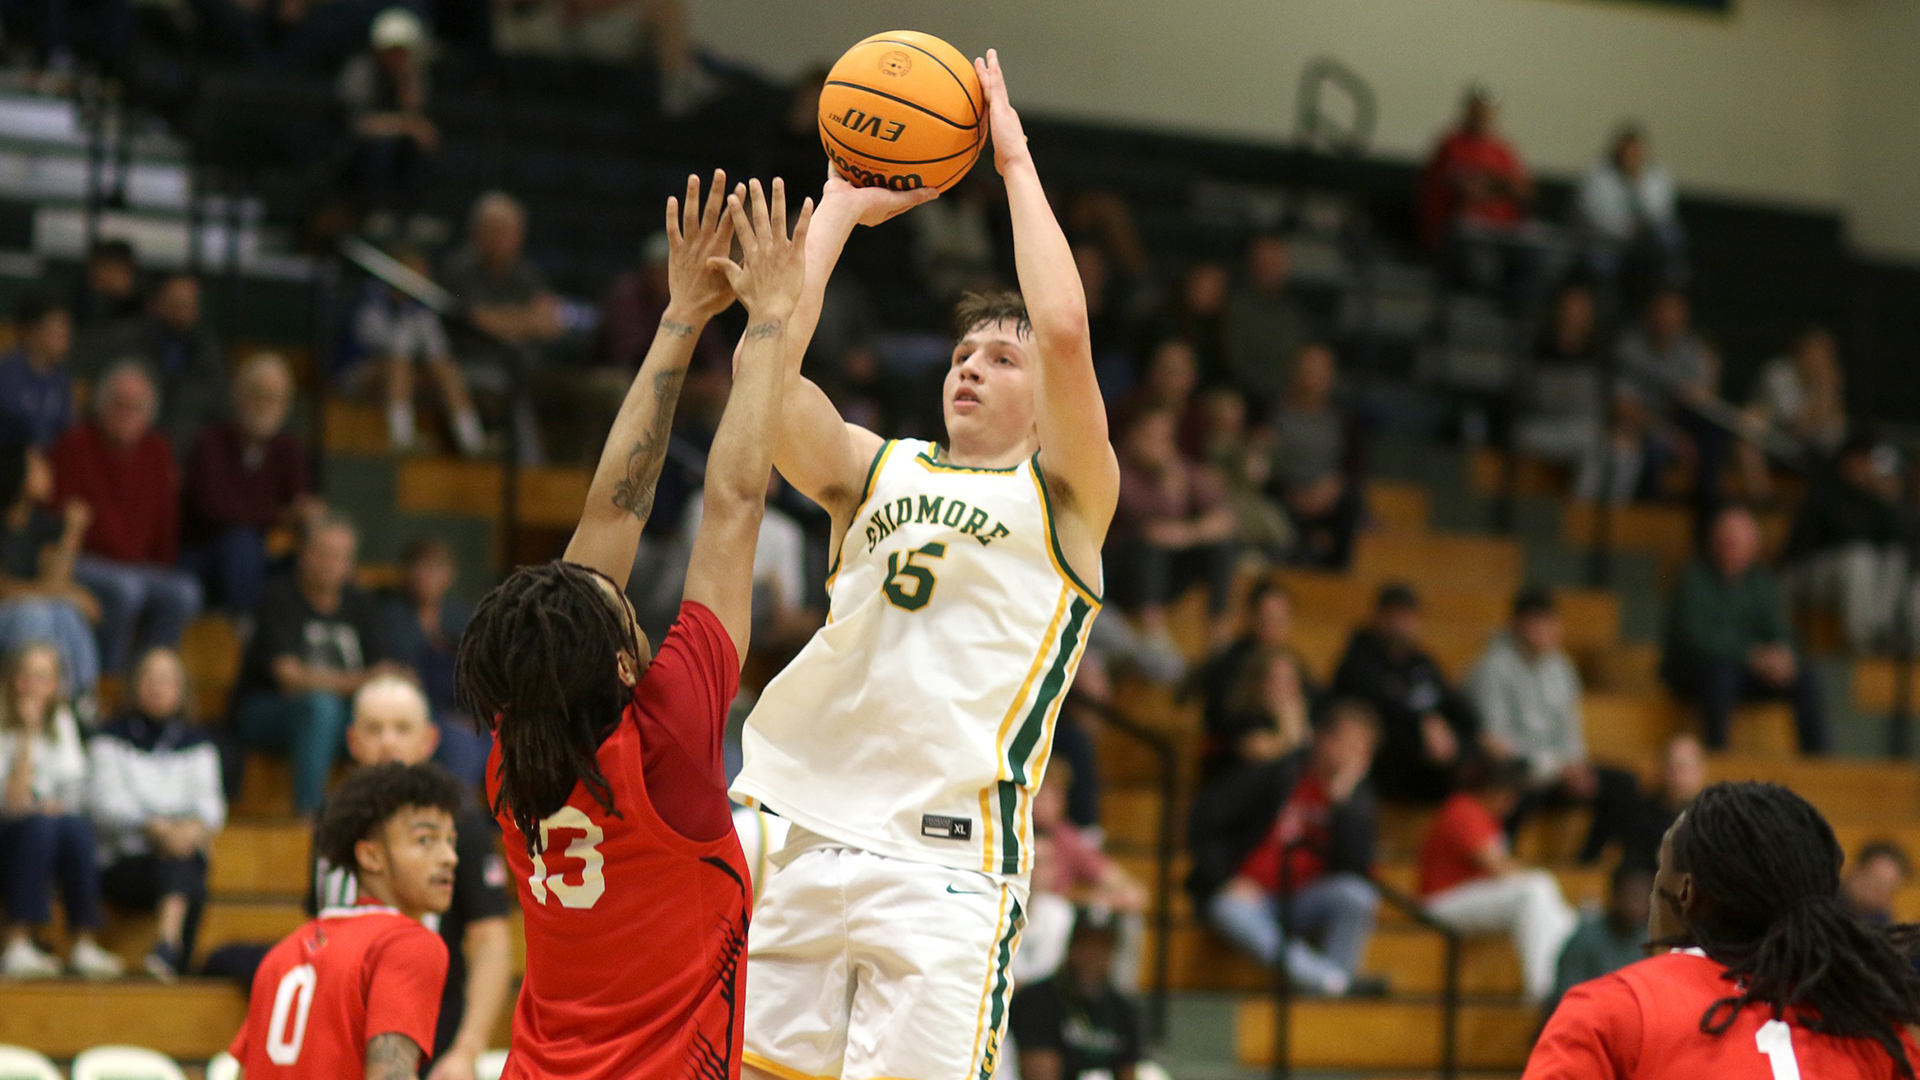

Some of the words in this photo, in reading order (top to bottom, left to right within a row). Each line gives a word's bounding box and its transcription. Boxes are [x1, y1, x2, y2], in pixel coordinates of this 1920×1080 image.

[841, 108, 906, 142] EVO
[865, 494, 1010, 554] SKIDMORE
[882, 541, 948, 612] 15
[513, 805, 605, 909] 13
[954, 823, 967, 835] XL
[266, 964, 317, 1065] 0
[1755, 1019, 1800, 1080] 1
